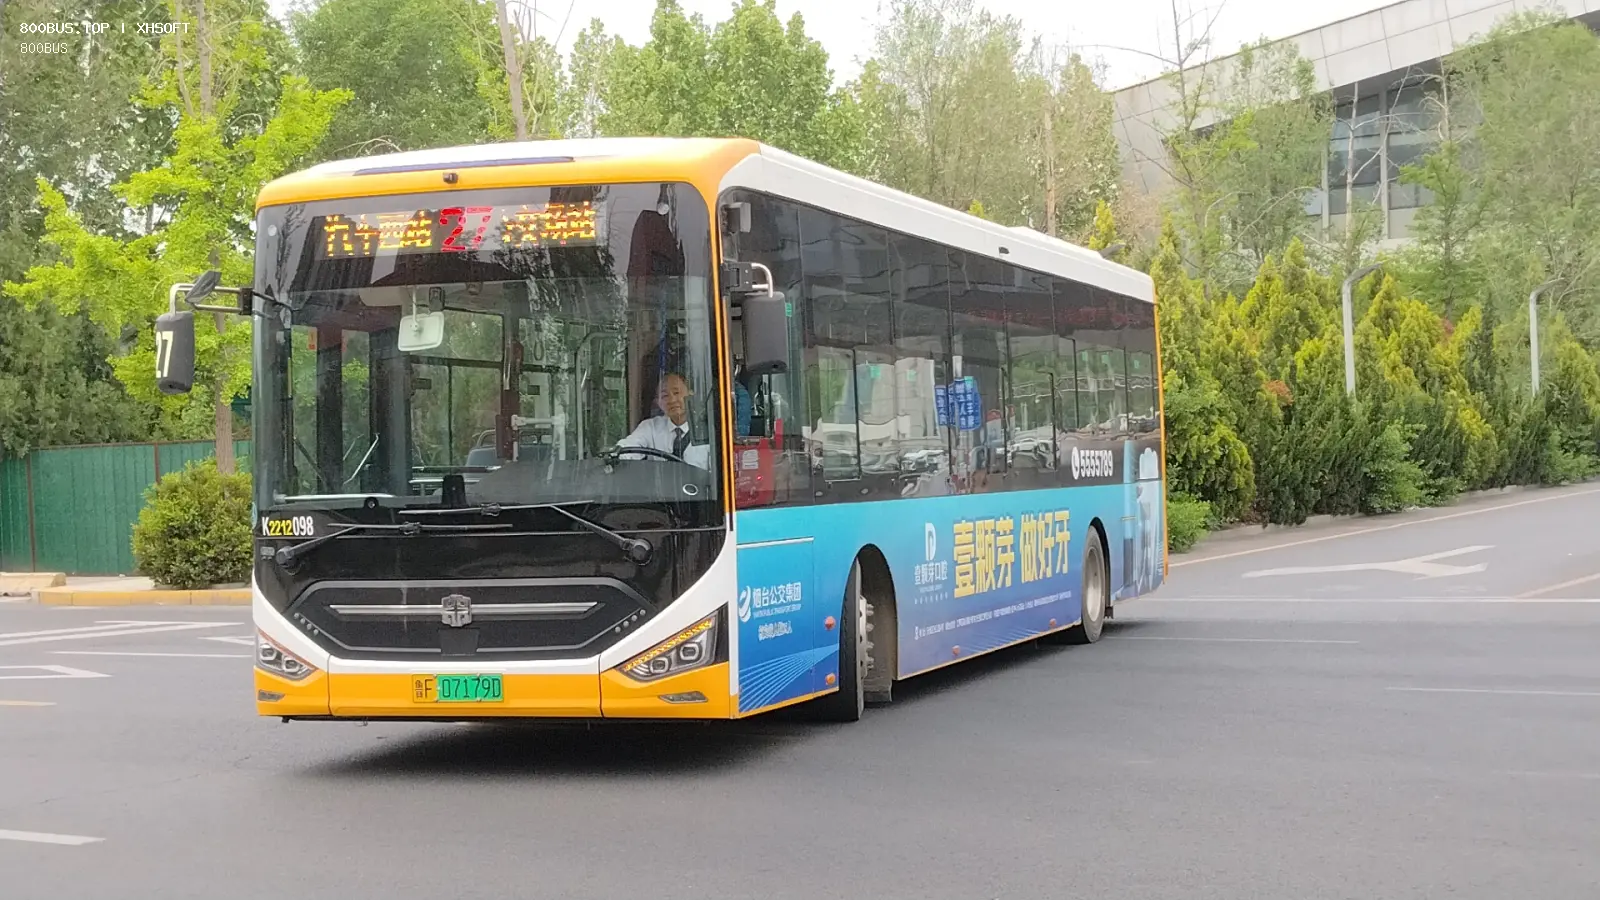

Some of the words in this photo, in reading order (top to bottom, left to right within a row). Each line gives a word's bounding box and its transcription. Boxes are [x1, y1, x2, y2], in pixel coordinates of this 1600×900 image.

[439, 206, 494, 253] 27
[1079, 448, 1114, 478] 5555789
[261, 515, 315, 537] K2212098
[952, 515, 1015, 599] 壹颗芽
[1019, 509, 1071, 583] 做好牙
[752, 581, 802, 608] 烟台公交集团
